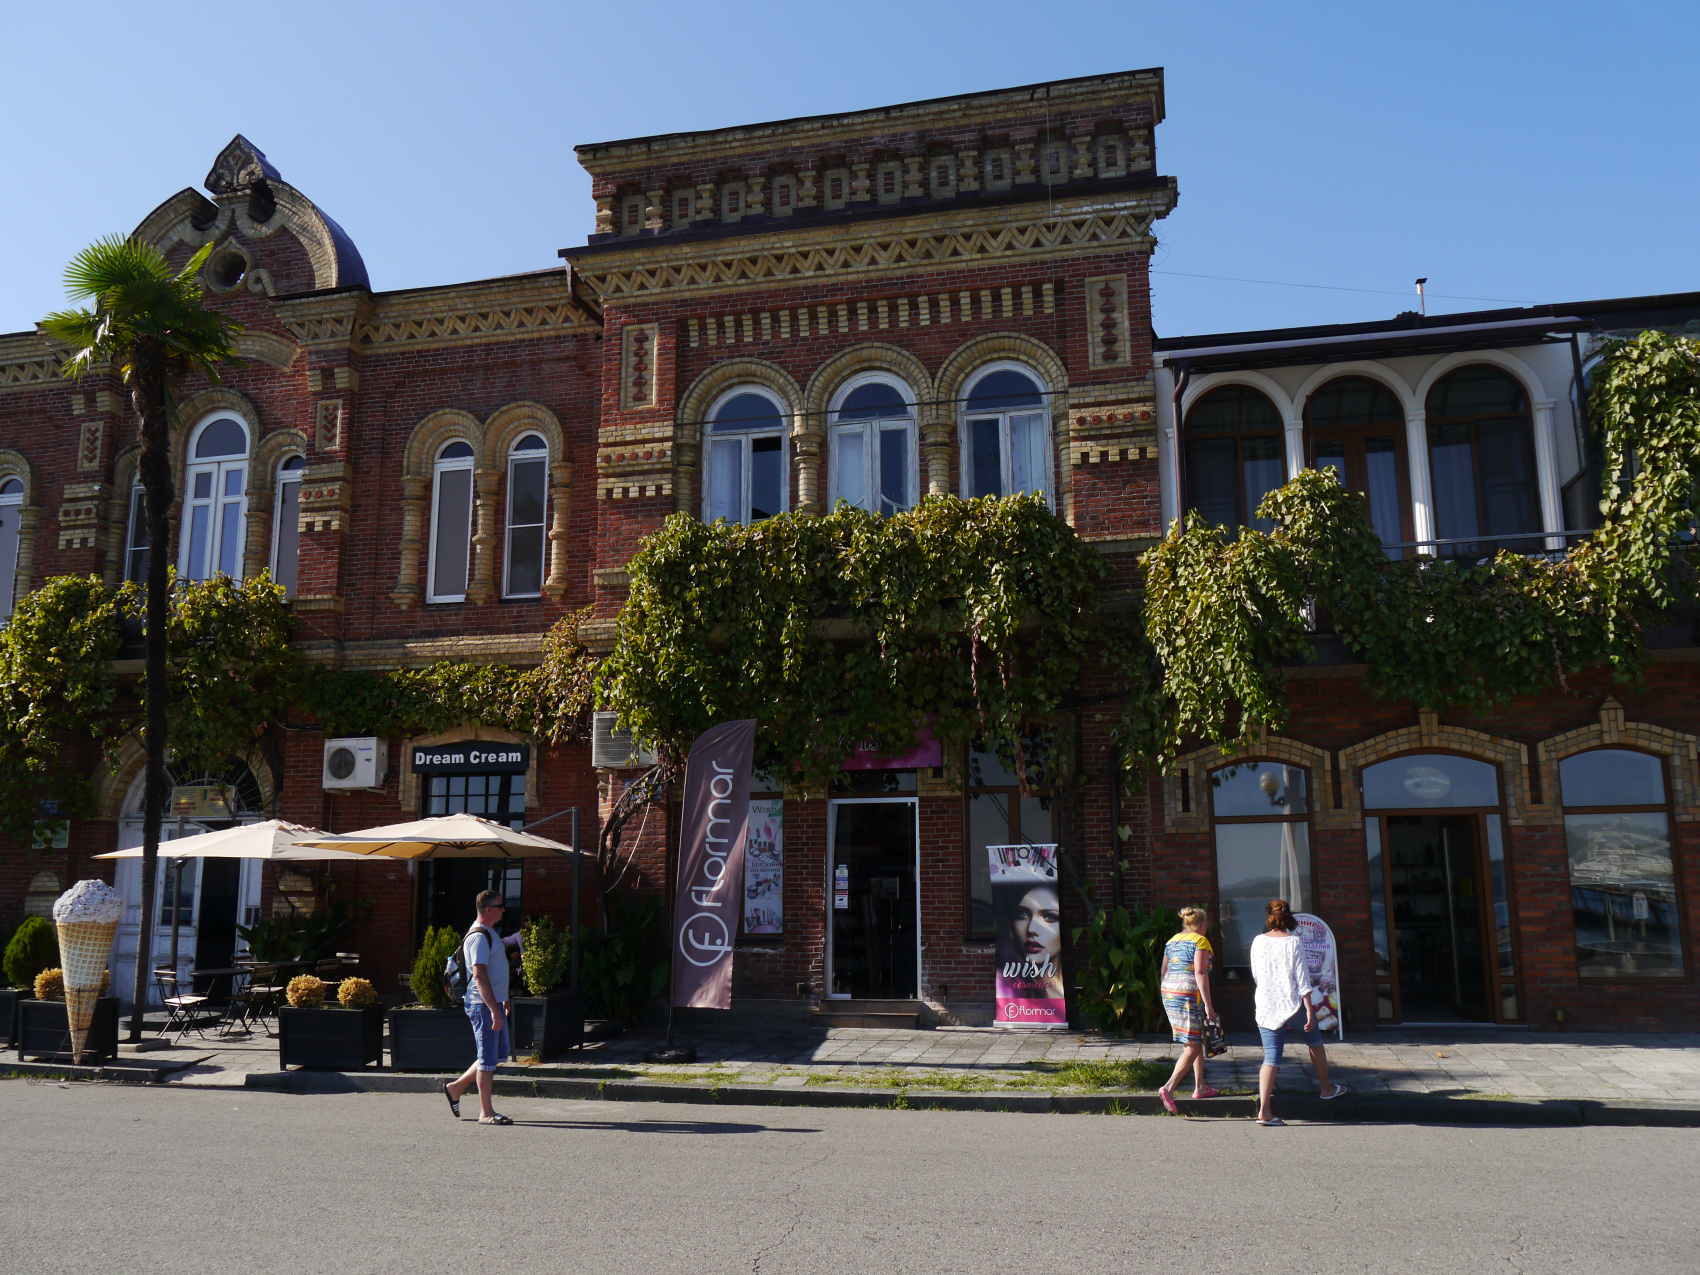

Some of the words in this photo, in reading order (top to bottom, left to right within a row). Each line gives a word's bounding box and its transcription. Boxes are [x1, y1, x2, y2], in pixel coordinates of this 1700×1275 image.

[415, 752, 465, 765] Dream
[469, 750, 521, 764] Cream
[752, 805, 777, 814] Wish
[691, 760, 734, 907] flormar
[1002, 953, 1058, 979] wish
[1013, 980, 1054, 989] cosmetics
[1020, 1005, 1056, 1016] flormar
